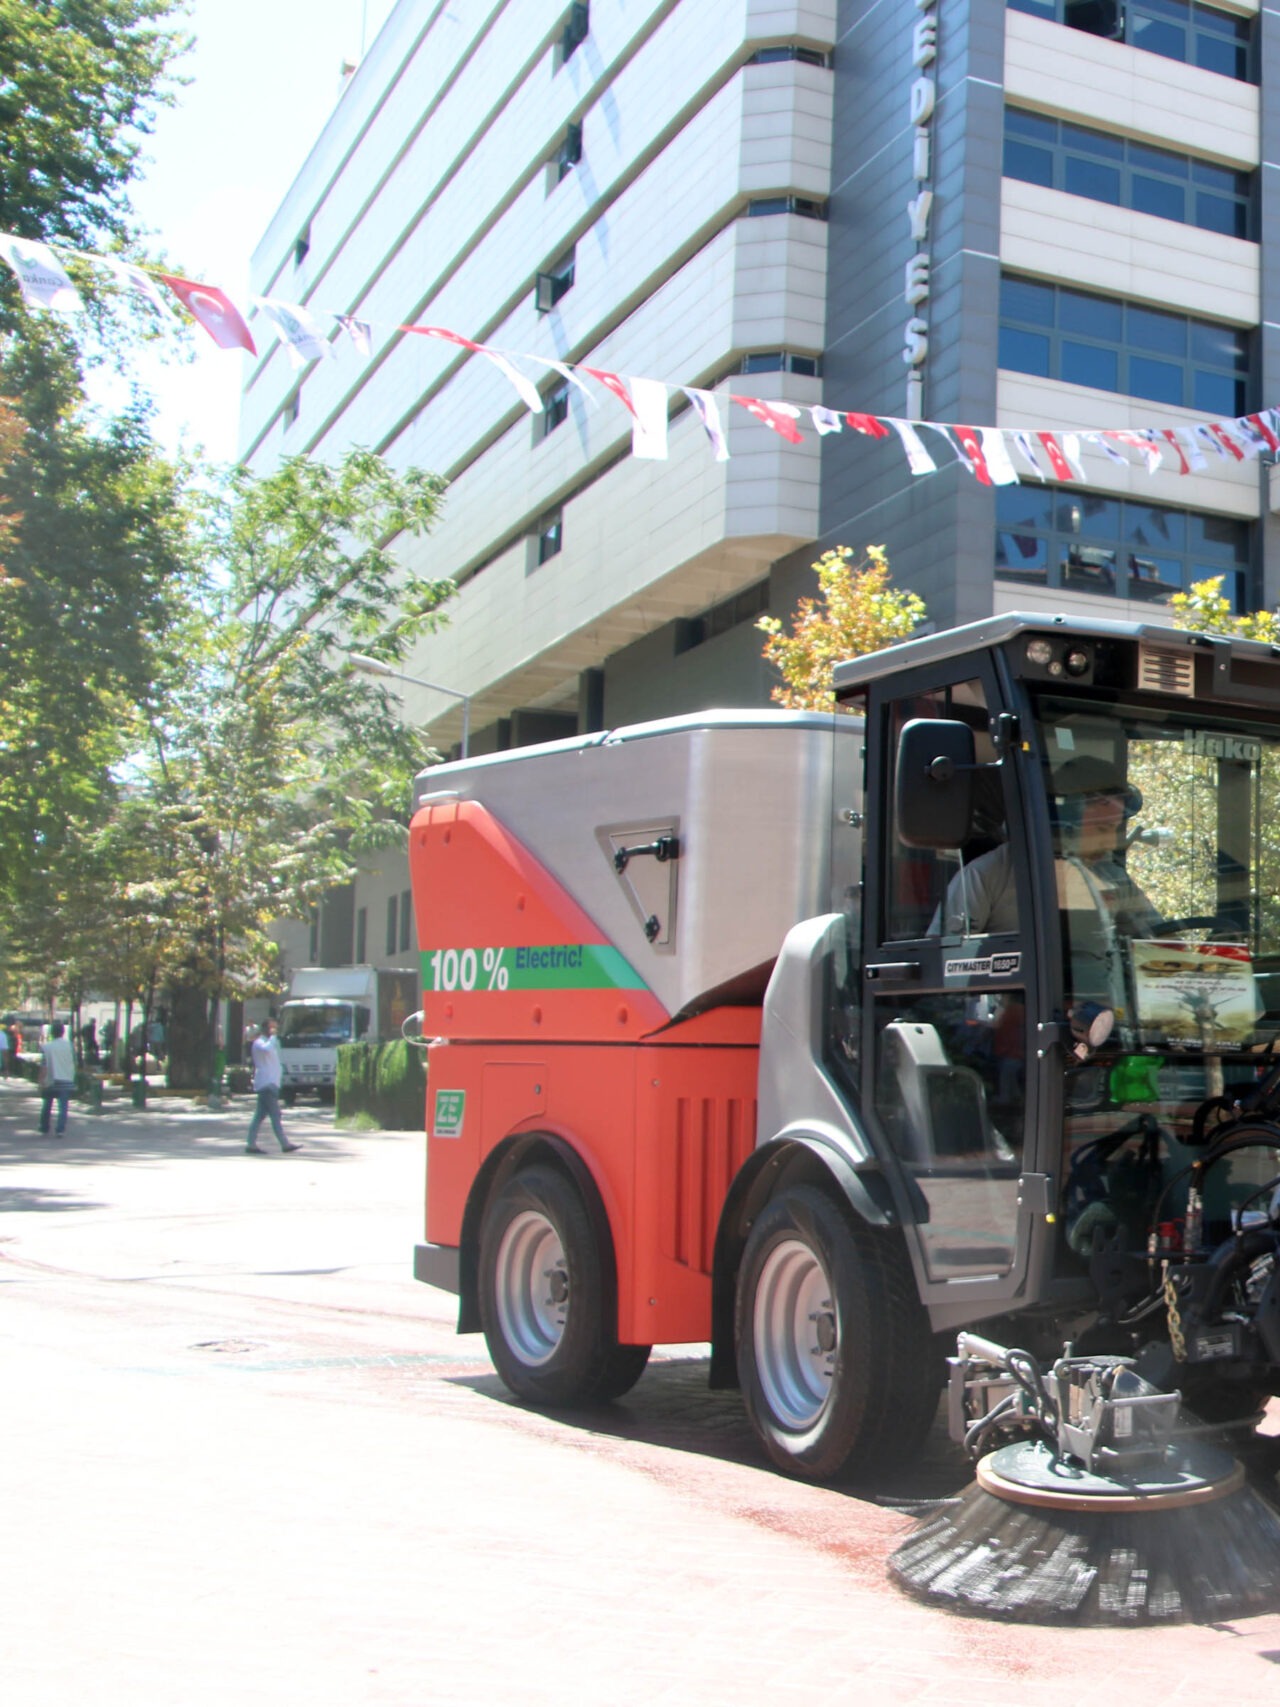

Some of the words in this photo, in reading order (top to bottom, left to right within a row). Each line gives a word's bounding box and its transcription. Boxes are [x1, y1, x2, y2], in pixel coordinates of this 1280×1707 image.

[1183, 728, 1261, 761] Hako
[515, 944, 583, 969] Electric!
[947, 961, 992, 973] CITYMASTER
